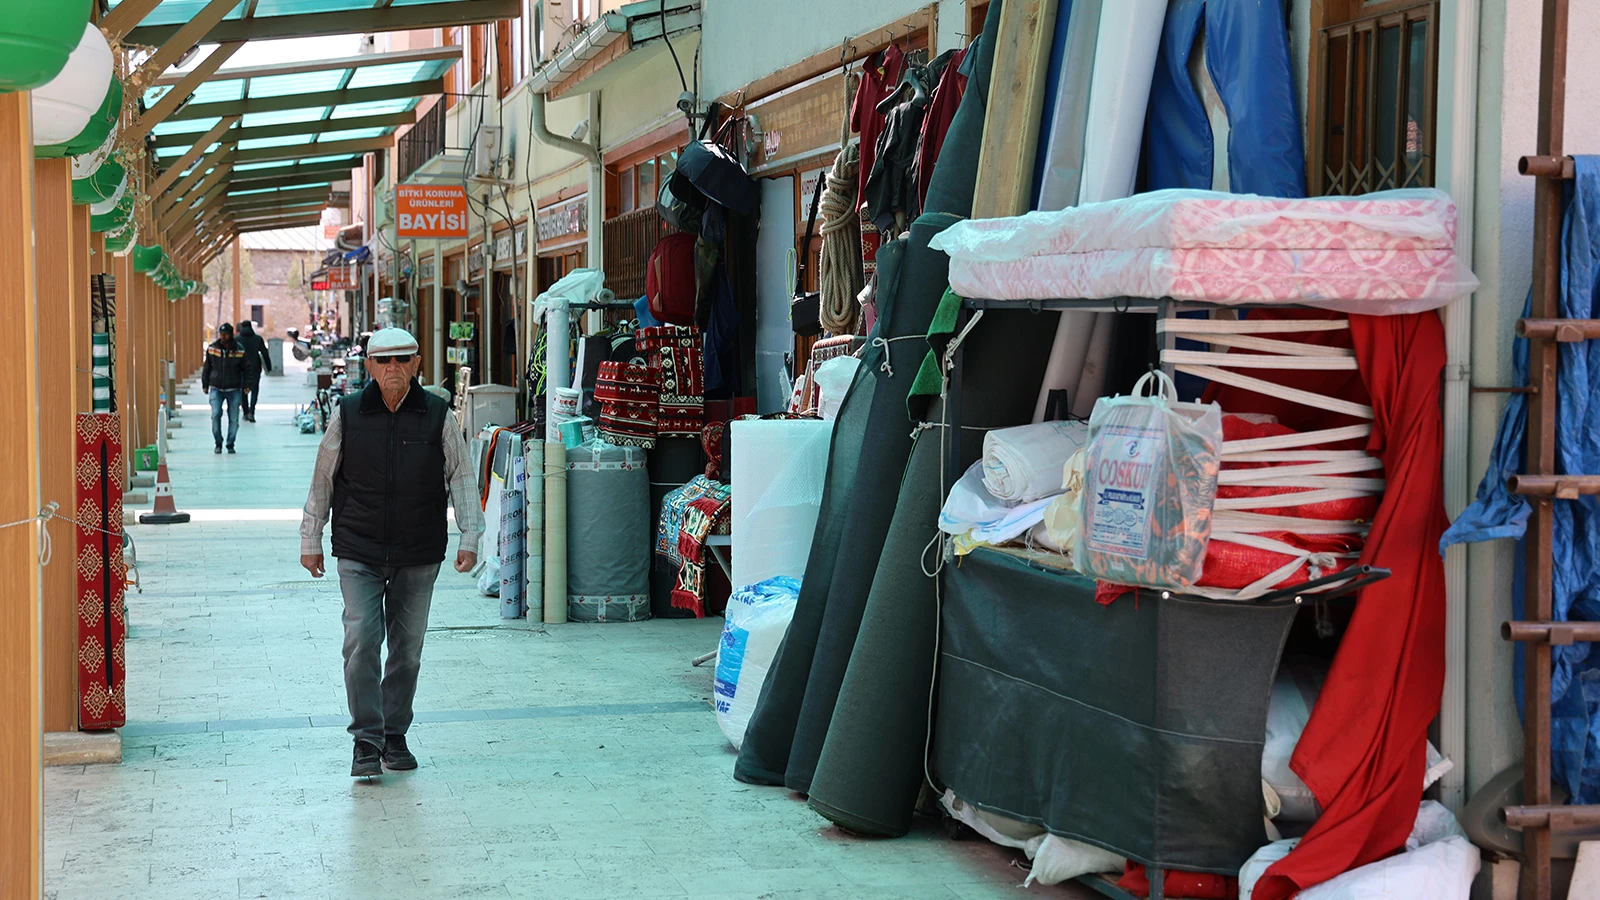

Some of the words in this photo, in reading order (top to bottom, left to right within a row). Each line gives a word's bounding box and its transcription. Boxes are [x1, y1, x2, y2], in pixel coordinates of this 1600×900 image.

[399, 189, 423, 197] BİTKİ
[425, 190, 464, 198] KORUMA
[409, 199, 454, 208] ÜRÜNLERİ
[399, 210, 466, 231] BAYİSİ
